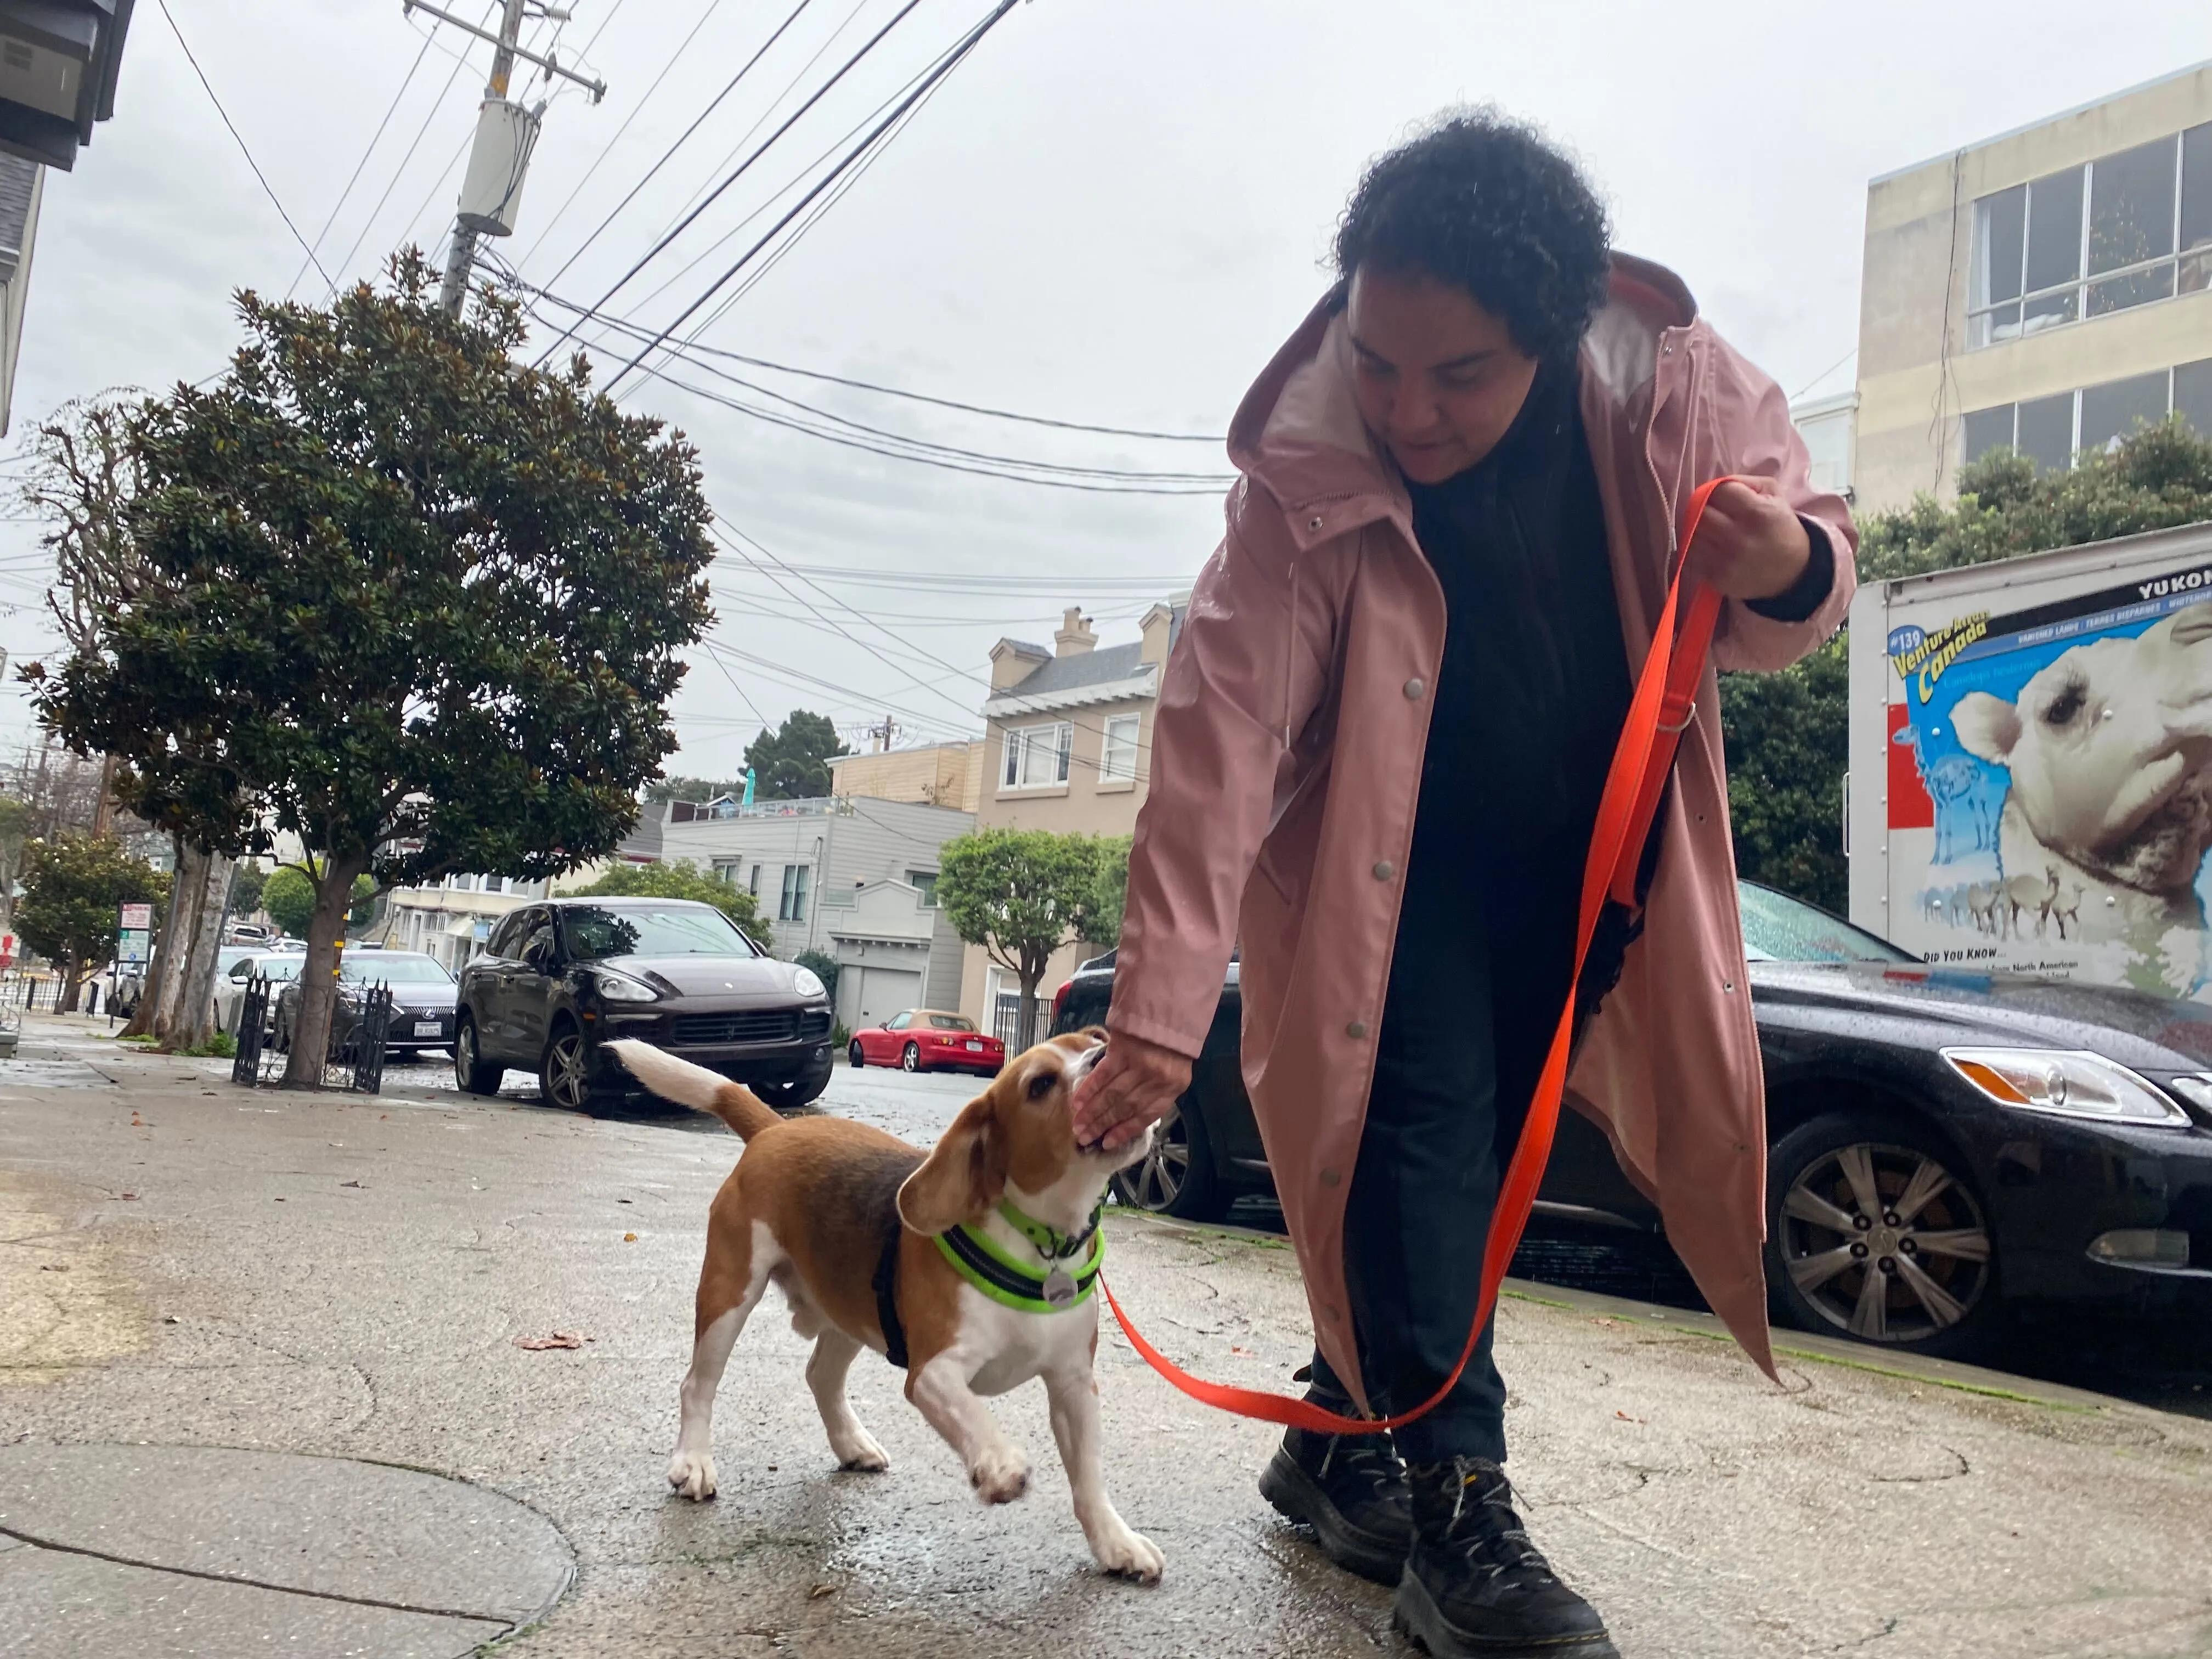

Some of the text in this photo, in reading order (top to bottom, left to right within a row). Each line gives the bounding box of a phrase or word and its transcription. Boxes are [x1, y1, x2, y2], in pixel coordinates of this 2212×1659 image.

[1890, 630, 1920, 651] #139
[1893, 627, 1951, 680] Venture
[1918, 621, 1987, 704] Canada
[1924, 951, 1940, 963] DID
[1944, 950, 1963, 962] YOU
[2013, 962, 2036, 972] North
[2039, 960, 2078, 970] American
